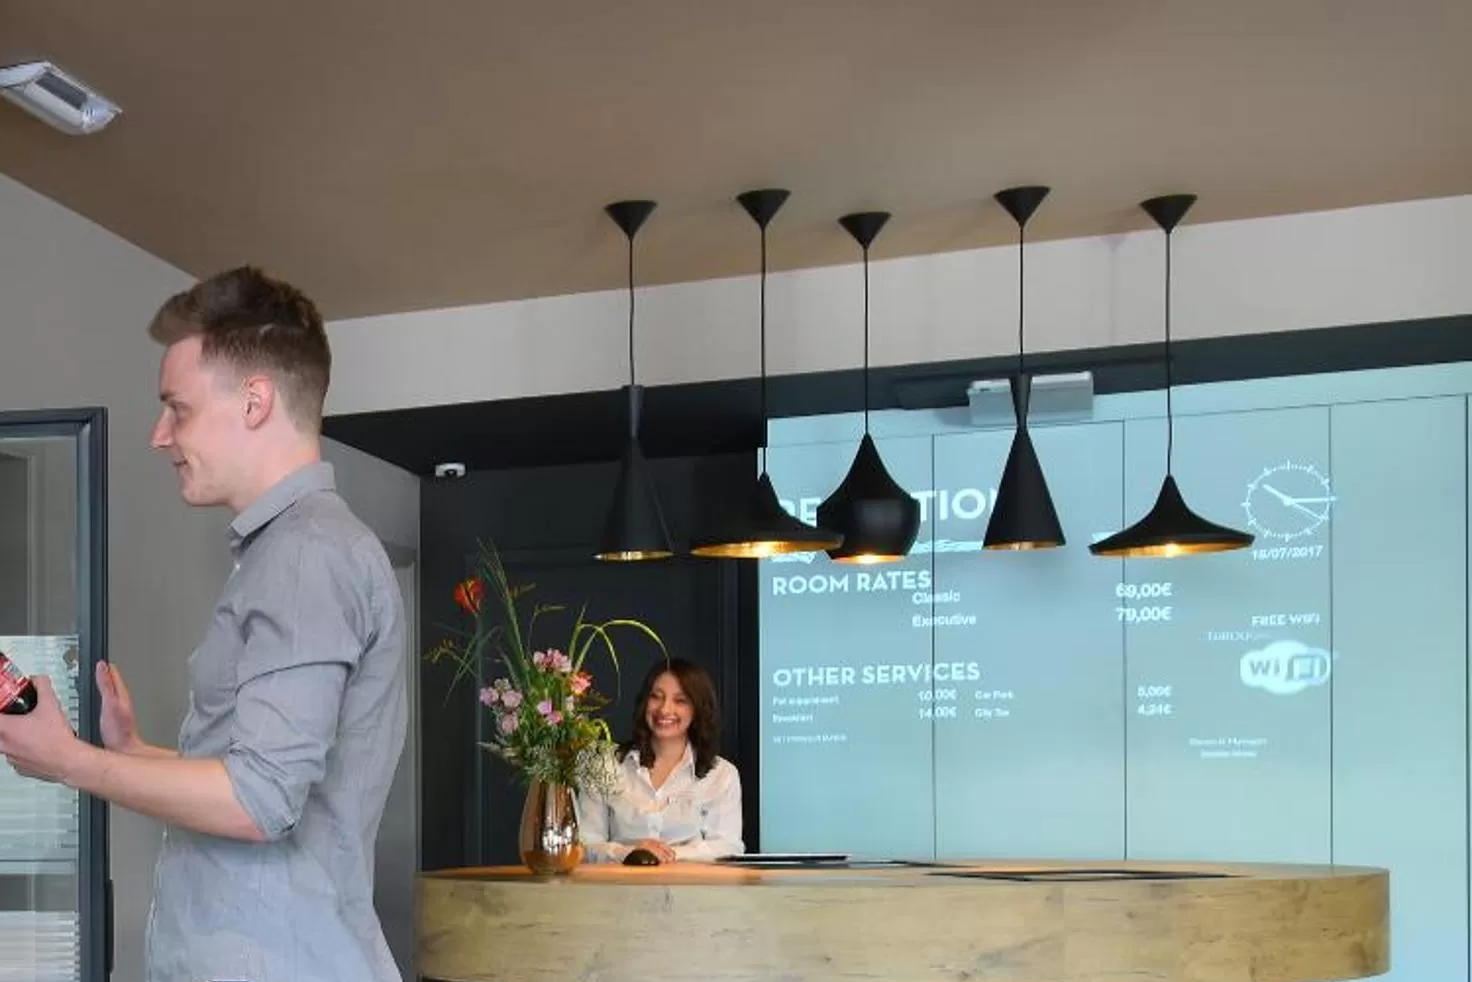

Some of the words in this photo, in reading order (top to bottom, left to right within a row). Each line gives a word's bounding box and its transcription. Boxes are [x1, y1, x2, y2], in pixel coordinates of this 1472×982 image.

[772, 574, 849, 596] ROOM
[856, 570, 933, 592] RATES
[912, 613, 977, 628] Executive
[773, 666, 856, 687] OTHER
[861, 662, 981, 684] SERVICES
